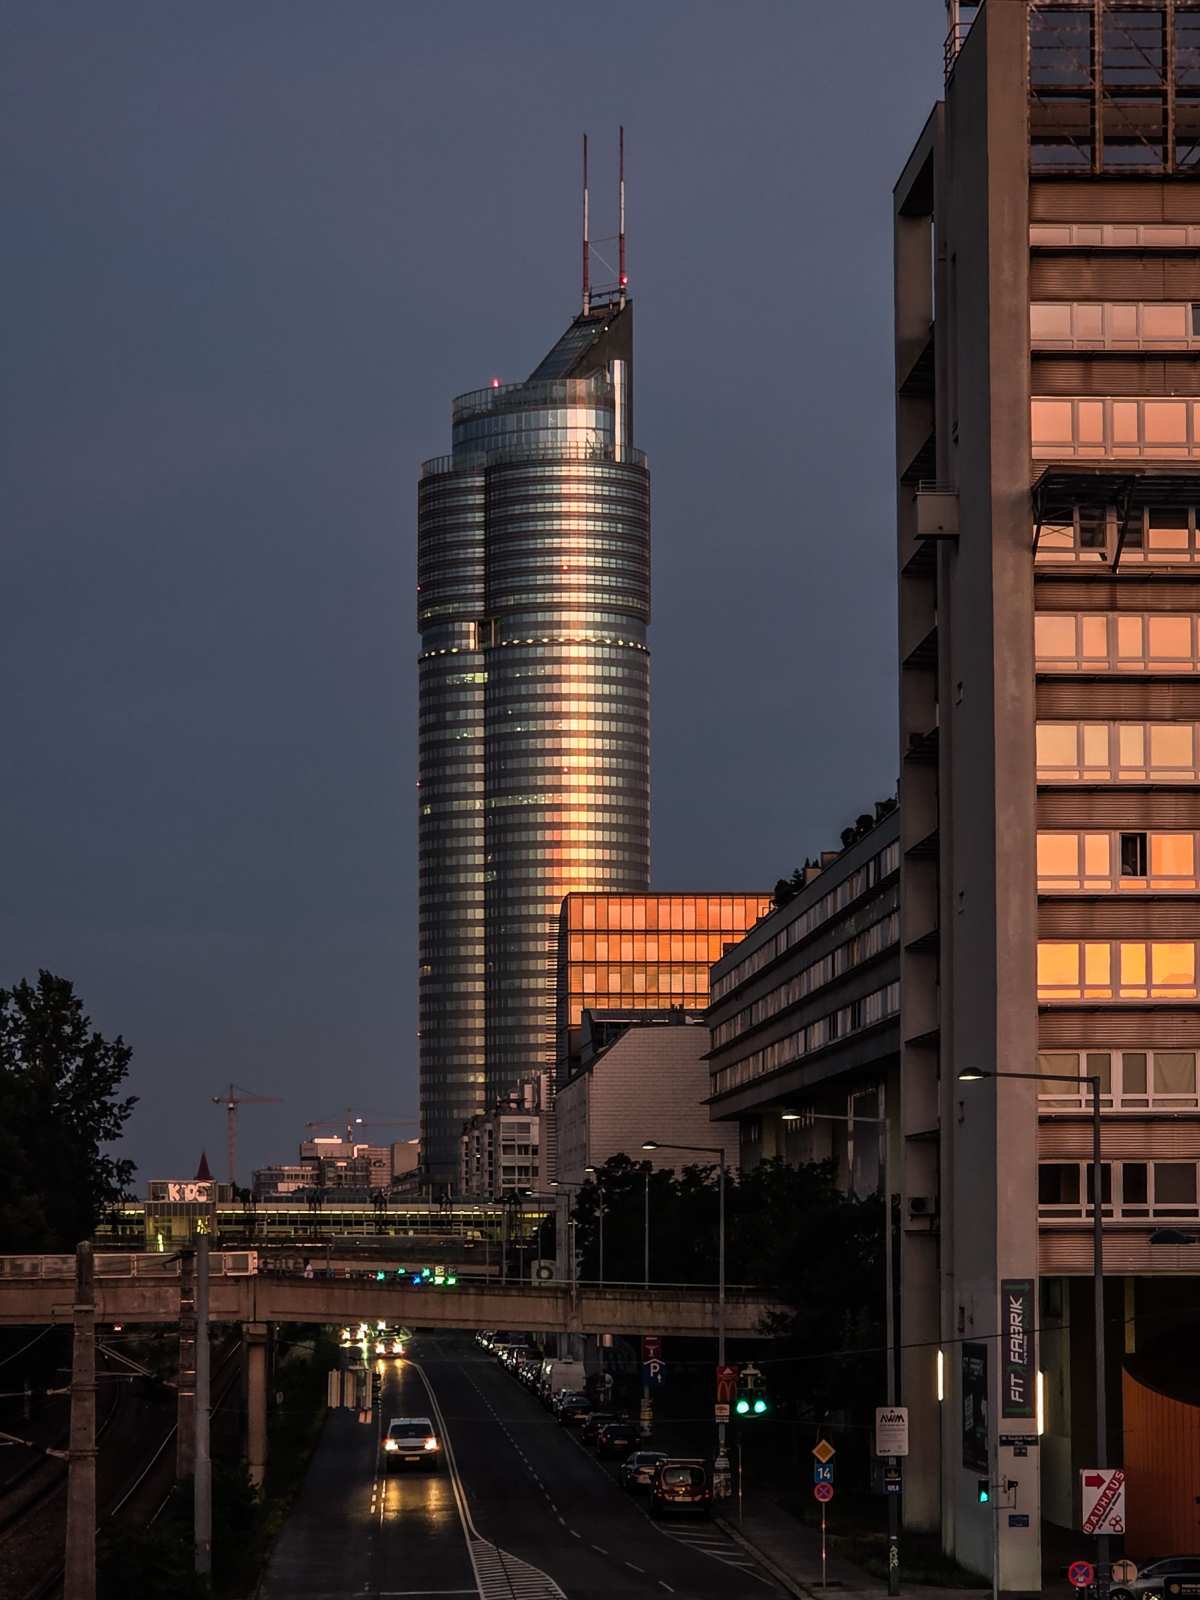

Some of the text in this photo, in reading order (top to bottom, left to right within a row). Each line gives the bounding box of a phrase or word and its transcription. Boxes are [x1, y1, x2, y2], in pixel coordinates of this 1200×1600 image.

[1009, 1295, 1024, 1403] FIT FABRIK
[817, 1467, 831, 1480] 14
[1082, 1471, 1125, 1534] BAUHAUS
